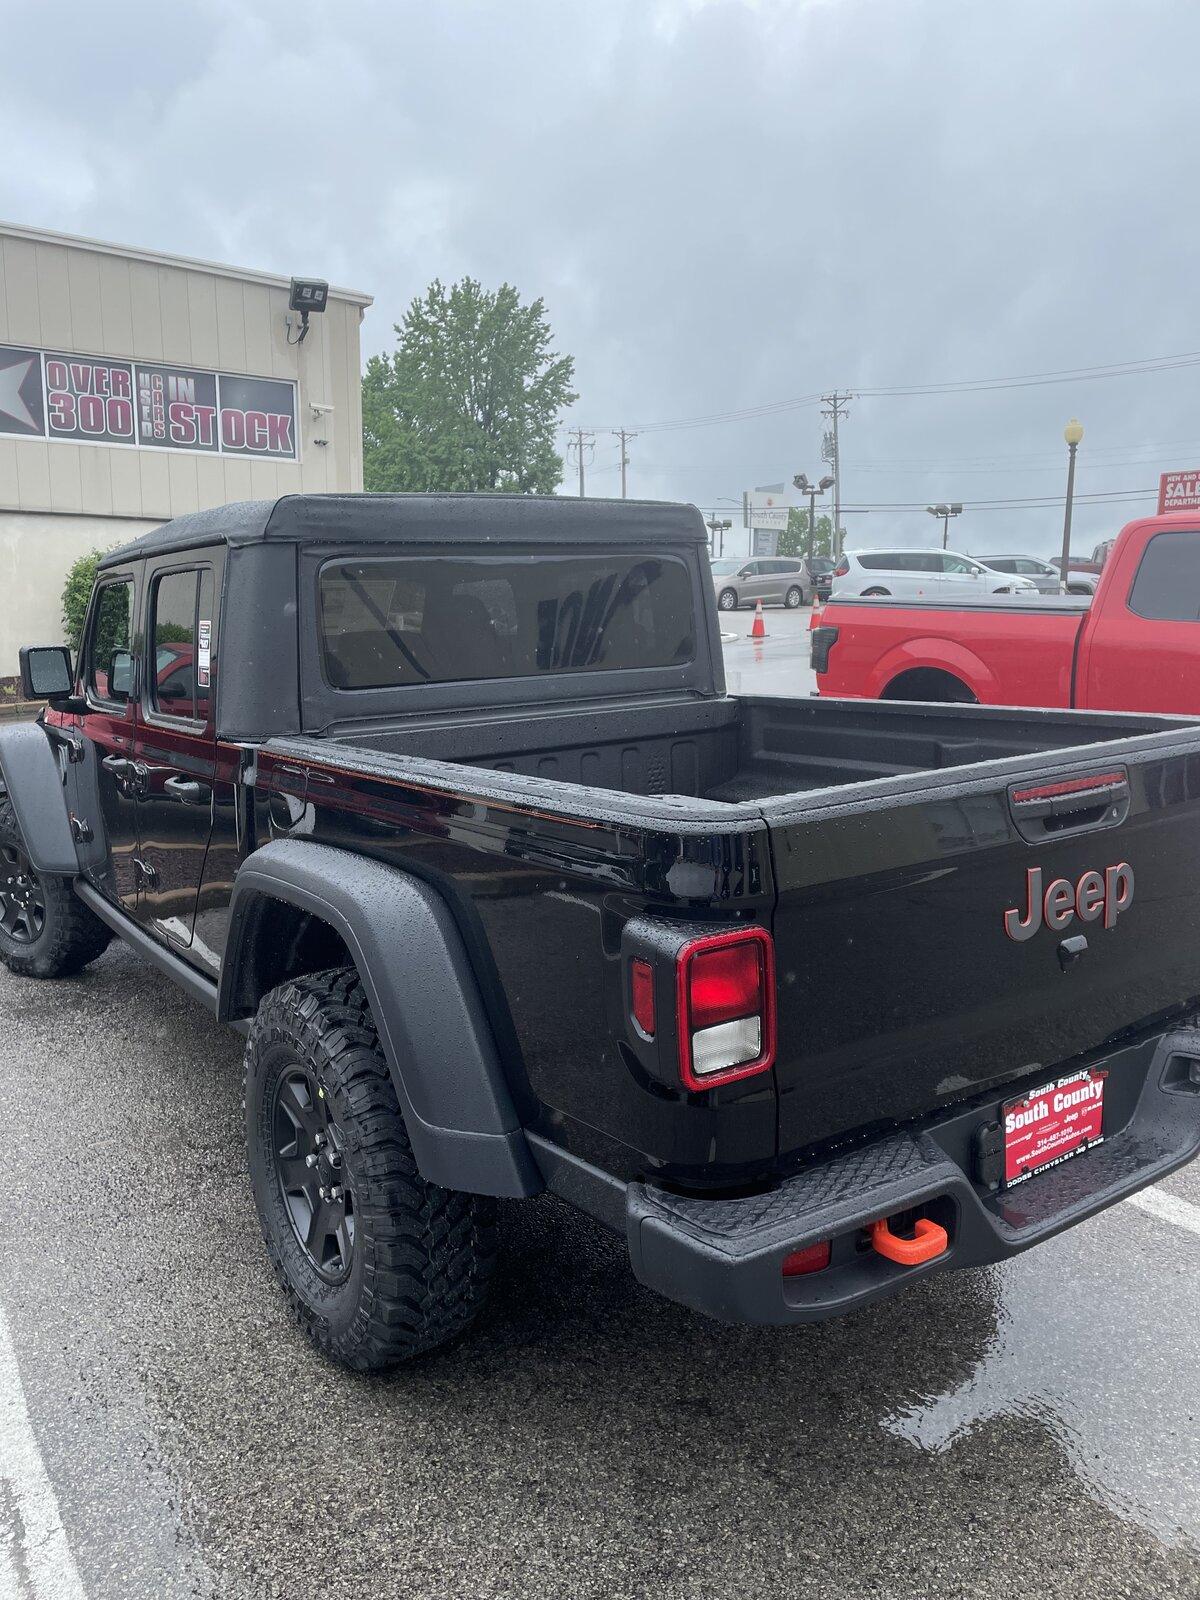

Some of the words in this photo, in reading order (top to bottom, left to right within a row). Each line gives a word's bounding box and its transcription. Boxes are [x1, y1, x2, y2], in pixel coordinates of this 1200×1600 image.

[46, 361, 132, 400] OVER
[139, 372, 153, 437] USED
[168, 376, 196, 403] IN
[48, 392, 134, 437] 300
[151, 374, 166, 439] CARS
[168, 402, 294, 454] STOCK
[1004, 862, 1135, 942] Jeep
[1005, 1100, 1049, 1134] South
[1053, 1080, 1104, 1113] County
[1029, 1083, 1055, 1100] South
[1057, 1070, 1089, 1088] County
[1034, 1152, 1074, 1175] CHRYSLER
